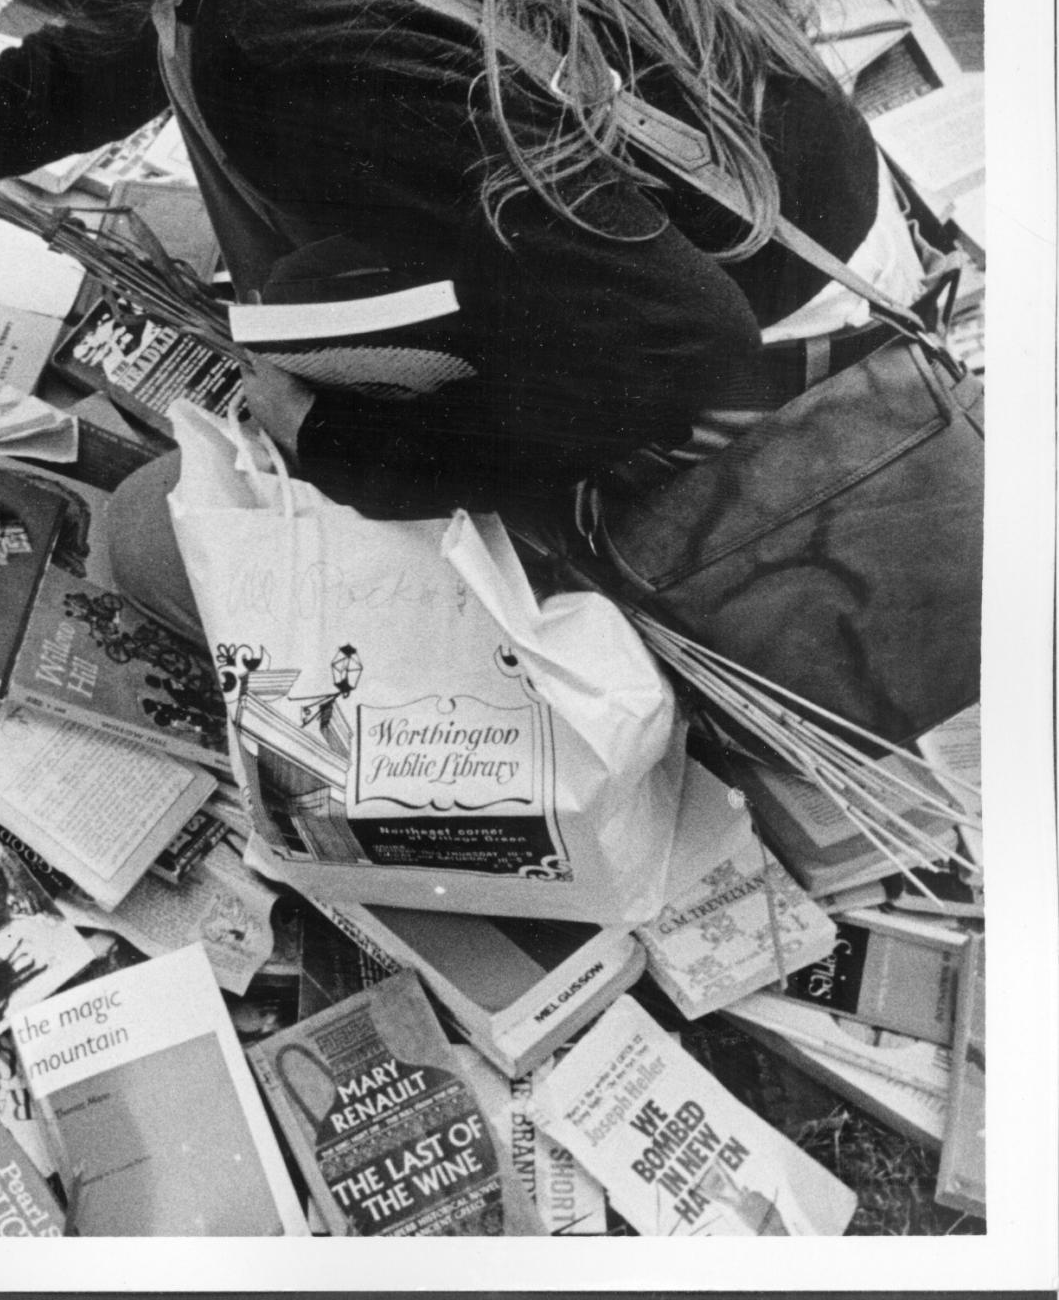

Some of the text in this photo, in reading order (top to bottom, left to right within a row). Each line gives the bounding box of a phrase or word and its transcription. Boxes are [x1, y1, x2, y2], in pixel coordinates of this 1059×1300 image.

[35, 620, 77, 688] Willow
[67, 655, 100, 699] Hill
[367, 718, 520, 750] Worthington
[367, 752, 521, 785] Public Library
[0, 828, 52, 874] GOOD
[18, 989, 123, 1044] the magic
[534, 960, 606, 1025] MEL GUSSOW
[28, 1026, 130, 1077] mountain
[336, 1057, 400, 1104] MARY
[330, 1070, 428, 1134] RENAULT
[583, 1055, 667, 1147] Joseph Heller
[629, 1097, 670, 1138] WE
[331, 1113, 485, 1207] THE LAST OF
[630, 1099, 707, 1185] BOMBED
[658, 1122, 722, 1199] IN NEW
[361, 1146, 484, 1223] THE WINE
[549, 1145, 577, 1223] SHORT
